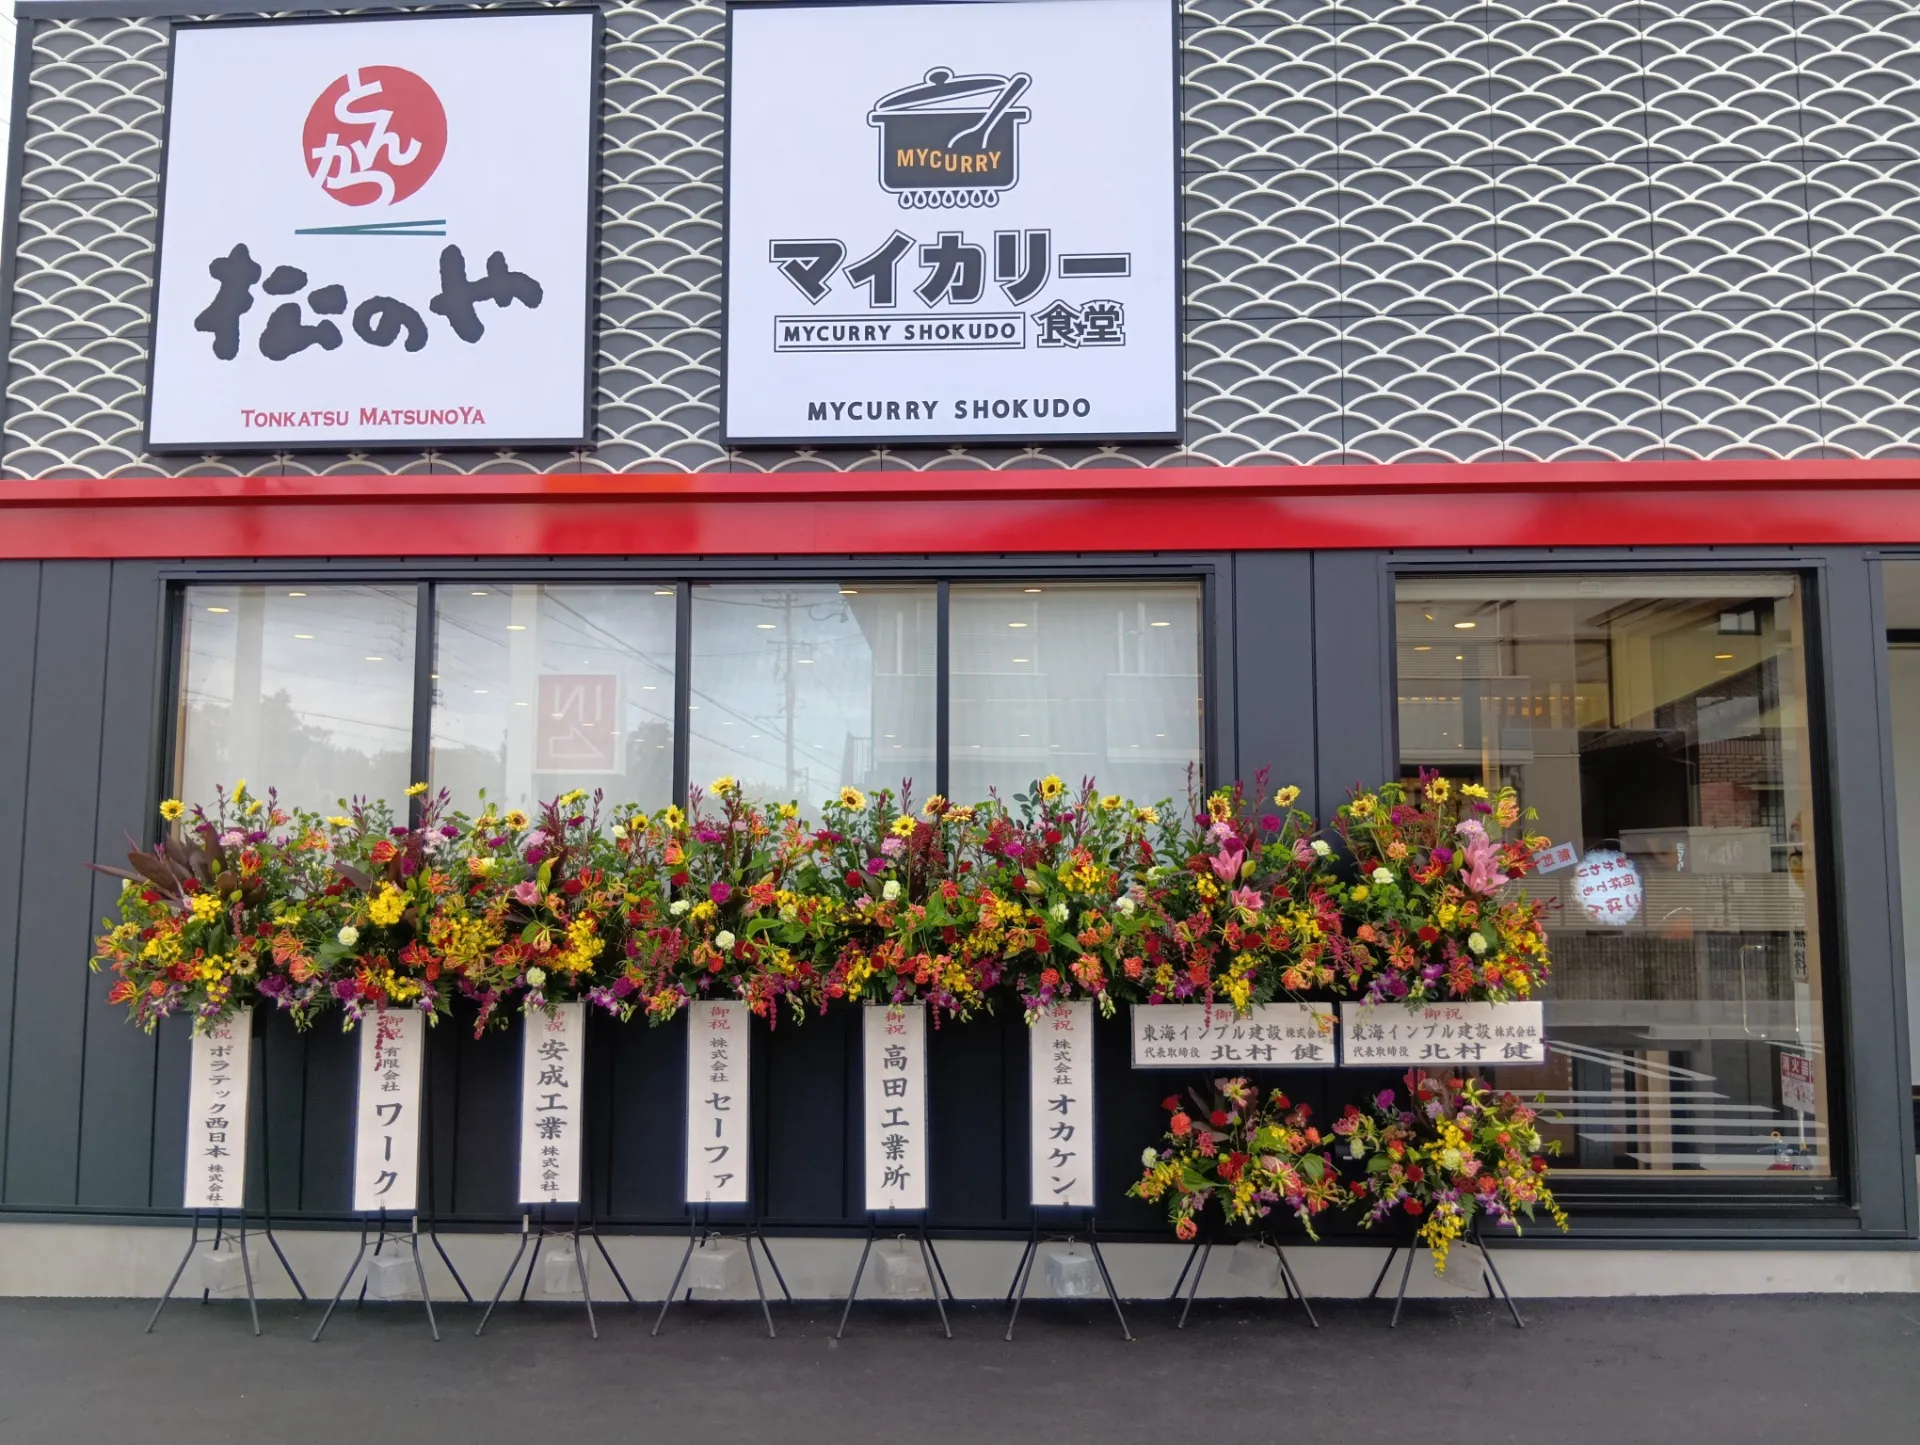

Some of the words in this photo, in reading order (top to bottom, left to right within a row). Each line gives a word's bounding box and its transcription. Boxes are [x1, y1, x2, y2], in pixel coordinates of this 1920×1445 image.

[312, 69, 421, 205] とんかつ
[897, 148, 1002, 173] MYCURRY
[769, 229, 1131, 309] マイカリー
[194, 243, 543, 361] 松のや
[784, 325, 891, 342] MYCURRY
[905, 322, 1016, 340] SHOKUDO
[1031, 299, 1126, 348] 食堂
[807, 402, 939, 421] MYCURRY
[954, 398, 1092, 419] SHOKUDO
[1578, 857, 1626, 877] おかわり
[1583, 874, 1635, 896] 何杯でも
[1587, 894, 1641, 918] ごはん
[708, 1006, 731, 1030] 御祝
[884, 1010, 907, 1035] 御祝
[1052, 1004, 1074, 1031] 御祝
[1423, 1007, 1463, 1020] 御祝
[881, 1044, 911, 1190] 高田工業所
